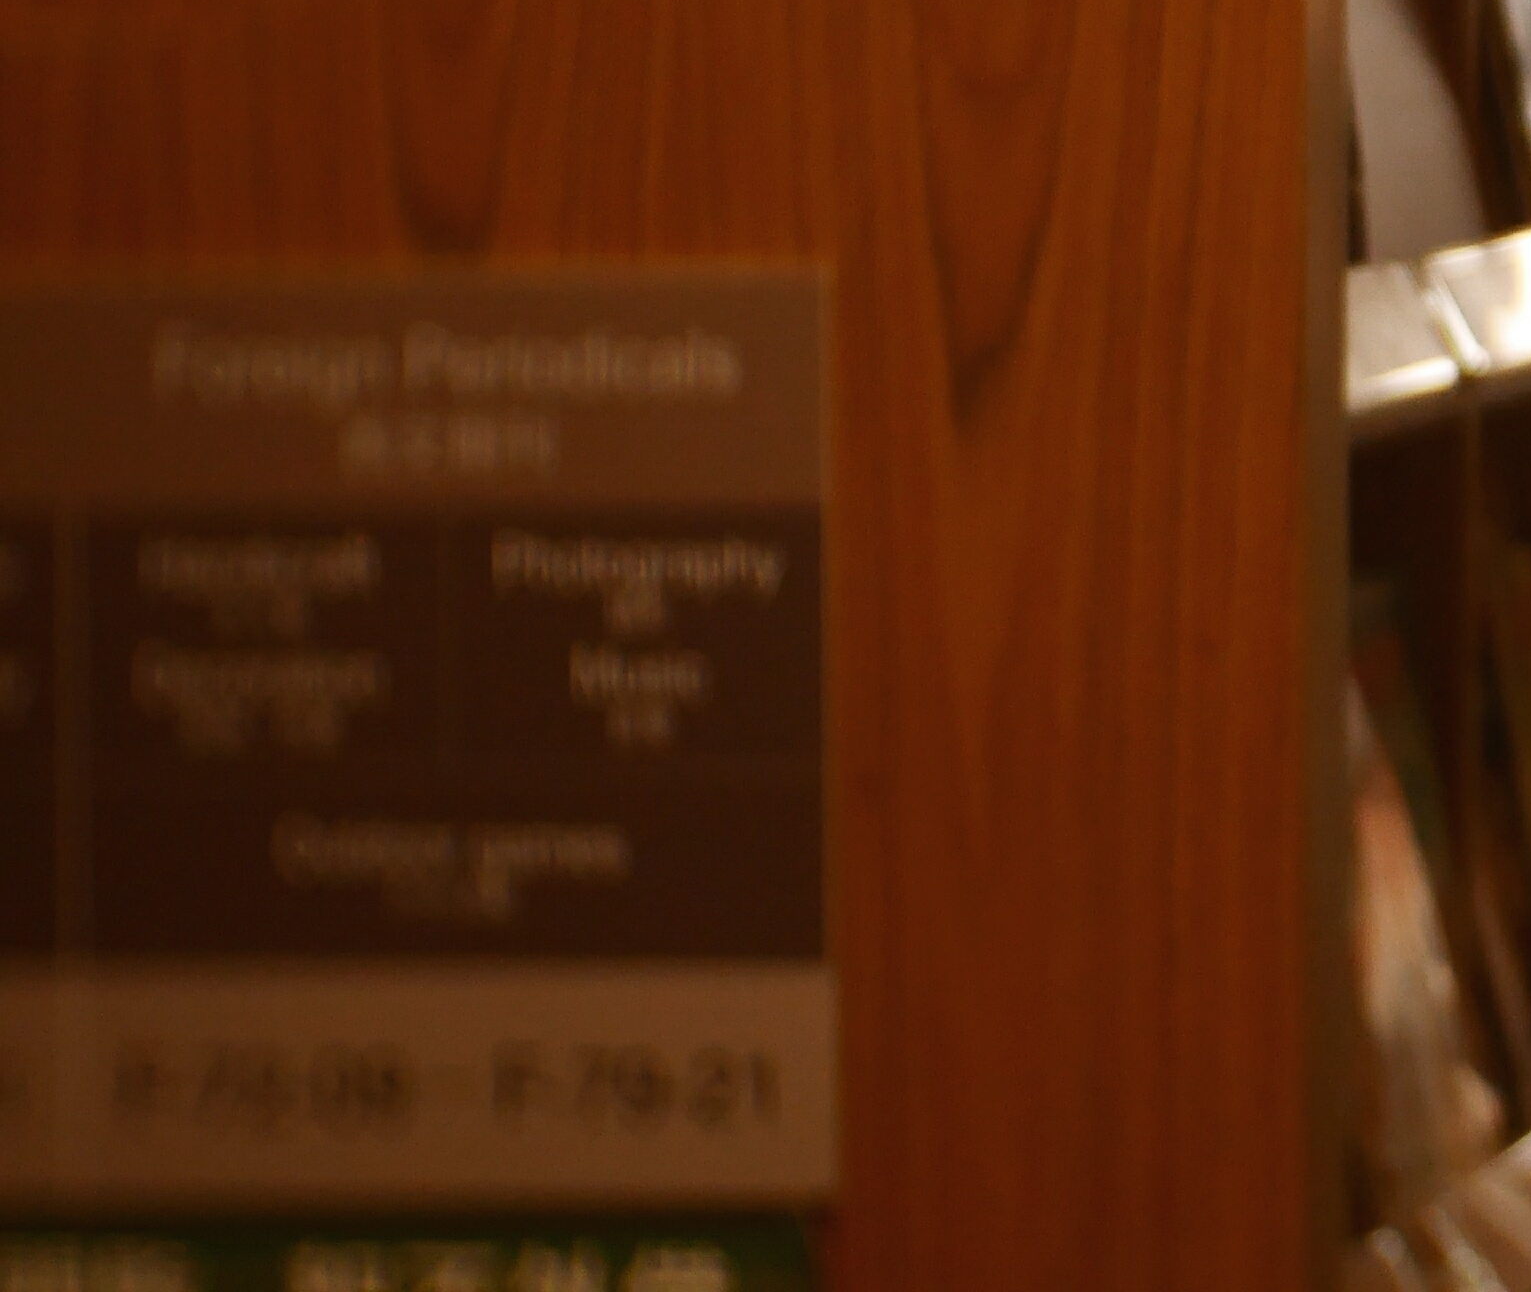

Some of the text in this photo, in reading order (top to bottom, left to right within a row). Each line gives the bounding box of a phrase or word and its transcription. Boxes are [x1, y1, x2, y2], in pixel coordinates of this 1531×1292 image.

[157, 325, 741, 410] Foreign Periodicals
[494, 534, 783, 598] Photography
